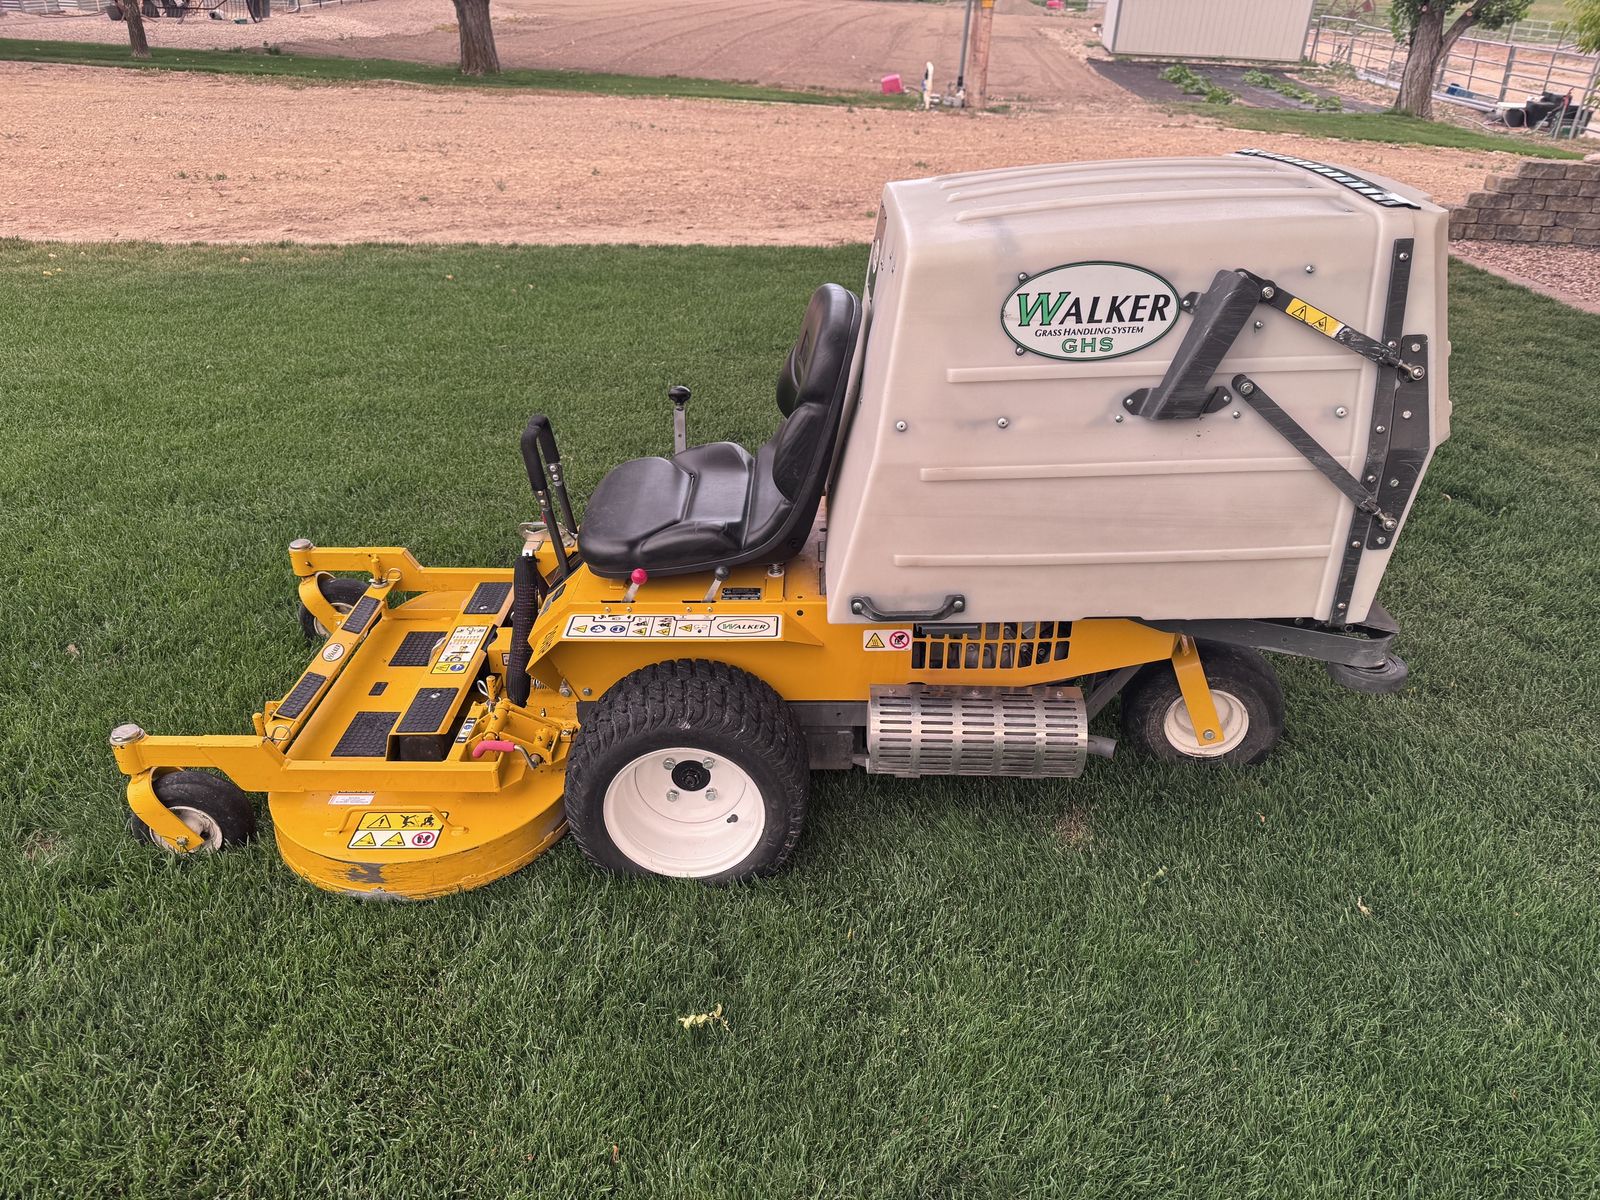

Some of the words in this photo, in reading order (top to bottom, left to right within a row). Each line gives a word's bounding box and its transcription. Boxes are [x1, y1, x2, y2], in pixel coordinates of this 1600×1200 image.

[1017, 291, 1171, 327] WALKER
[1034, 328, 1062, 337] GRASS
[1063, 327, 1111, 336] HANDLING
[1111, 326, 1144, 335] SYSTEM
[1061, 337, 1114, 354] GHS
